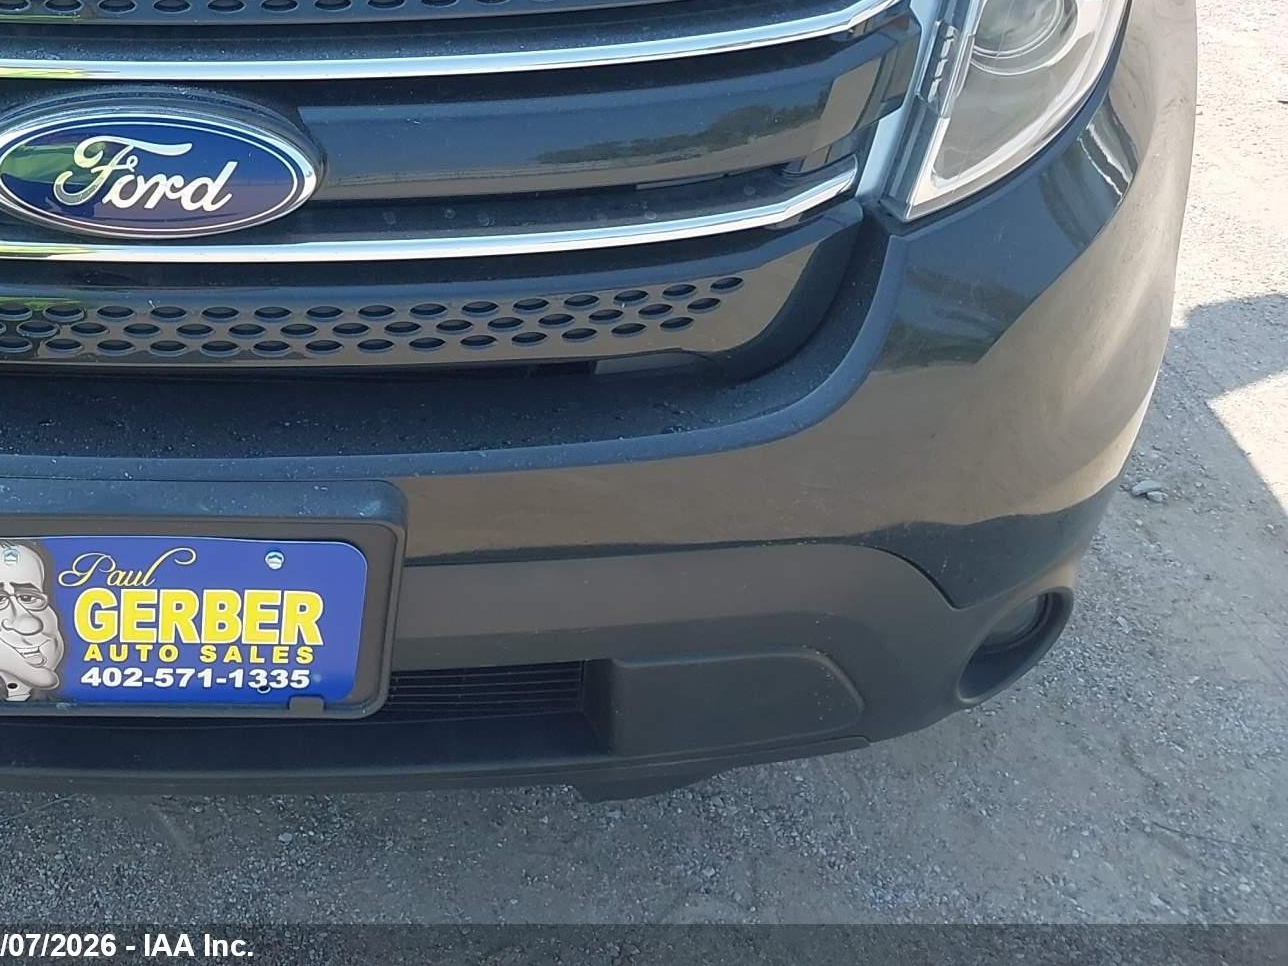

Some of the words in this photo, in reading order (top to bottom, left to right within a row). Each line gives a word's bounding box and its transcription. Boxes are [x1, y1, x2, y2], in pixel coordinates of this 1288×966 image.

[53, 135, 238, 212] Ford
[58, 547, 197, 587] Paul
[74, 588, 324, 646] GERBER
[83, 644, 179, 662] AUTO
[200, 646, 314, 664] SALES
[80, 667, 311, 690] 402-571-1335
